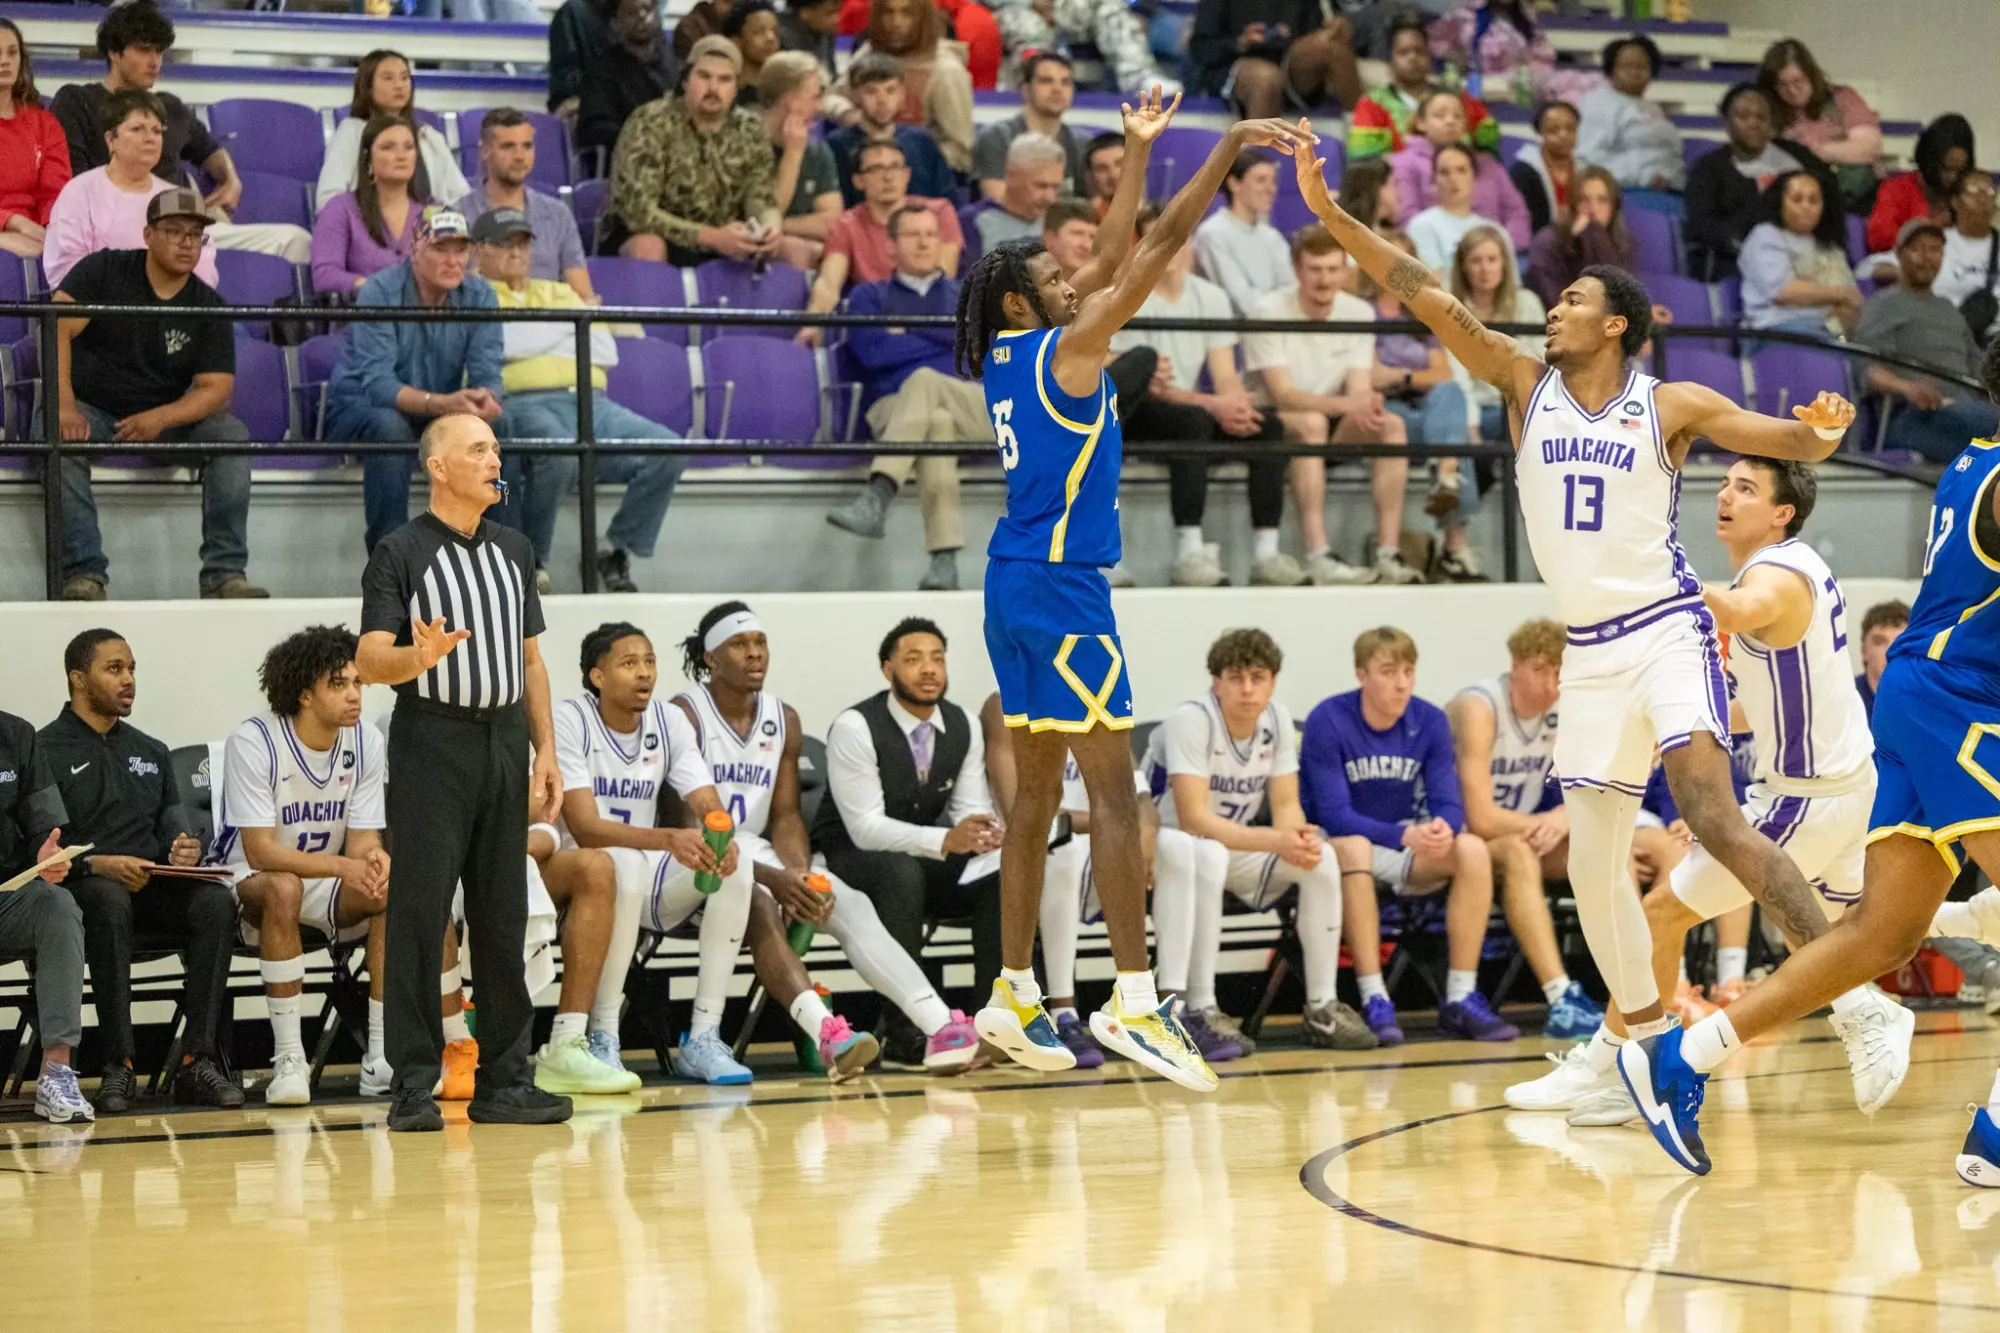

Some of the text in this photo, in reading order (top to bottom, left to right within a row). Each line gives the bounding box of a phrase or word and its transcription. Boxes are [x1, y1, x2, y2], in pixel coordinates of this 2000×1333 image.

[1626, 404, 1641, 413] BV
[992, 397, 1019, 471] 5
[1542, 437, 1636, 472] OUACHITA
[1563, 474, 1604, 532] 13
[128, 756, 158, 776] Tigers
